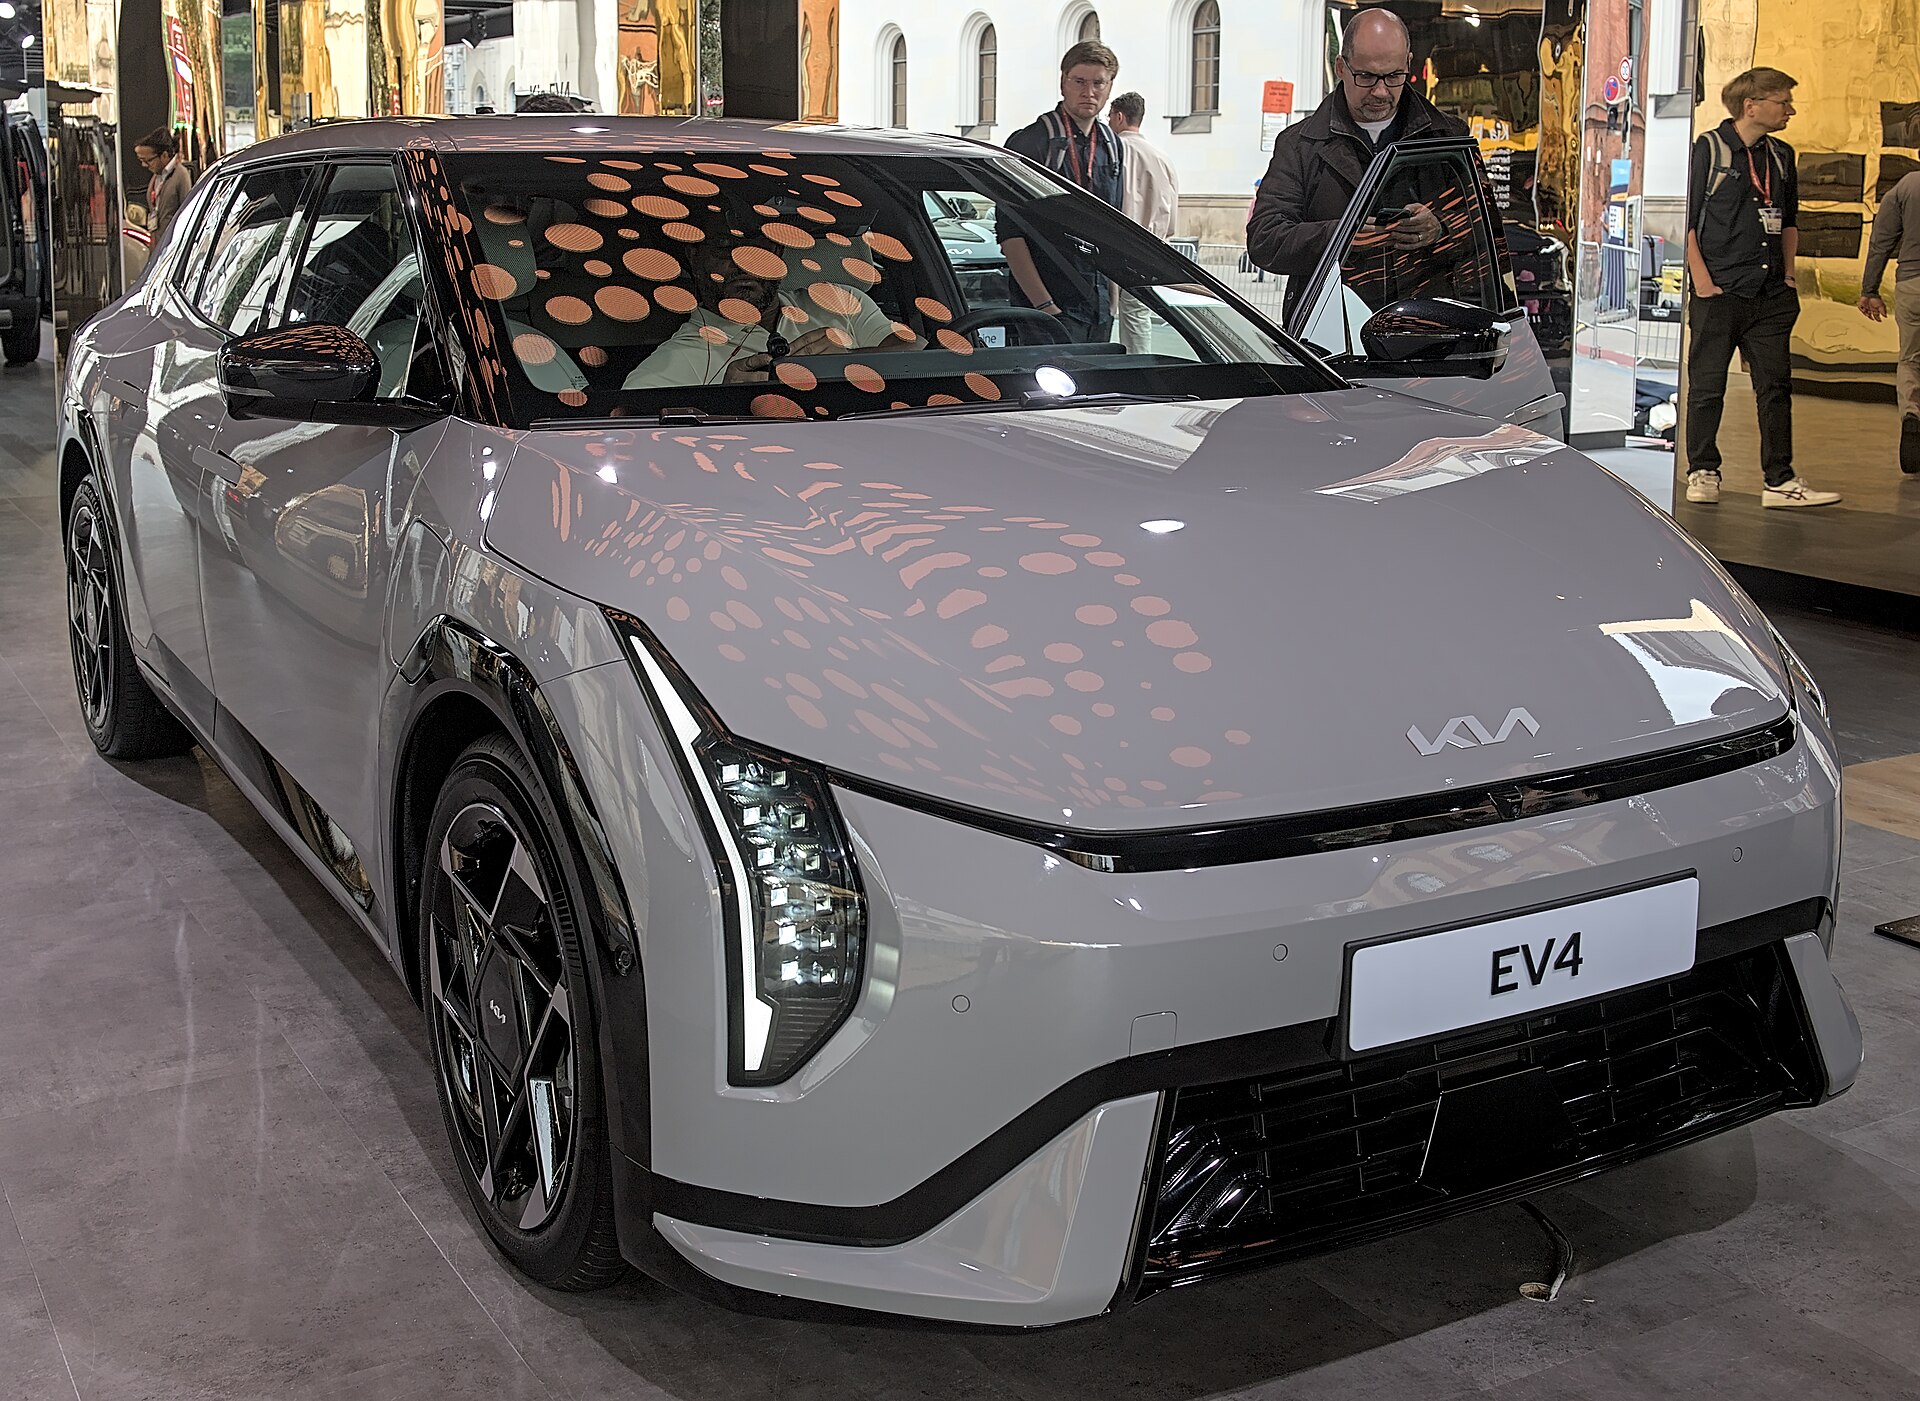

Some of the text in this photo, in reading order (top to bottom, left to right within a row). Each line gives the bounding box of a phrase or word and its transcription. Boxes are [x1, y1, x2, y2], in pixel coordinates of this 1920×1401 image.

[982, 333, 997, 344] ine
[1405, 706, 1541, 756] KIA
[1490, 931, 1584, 996] EV4
